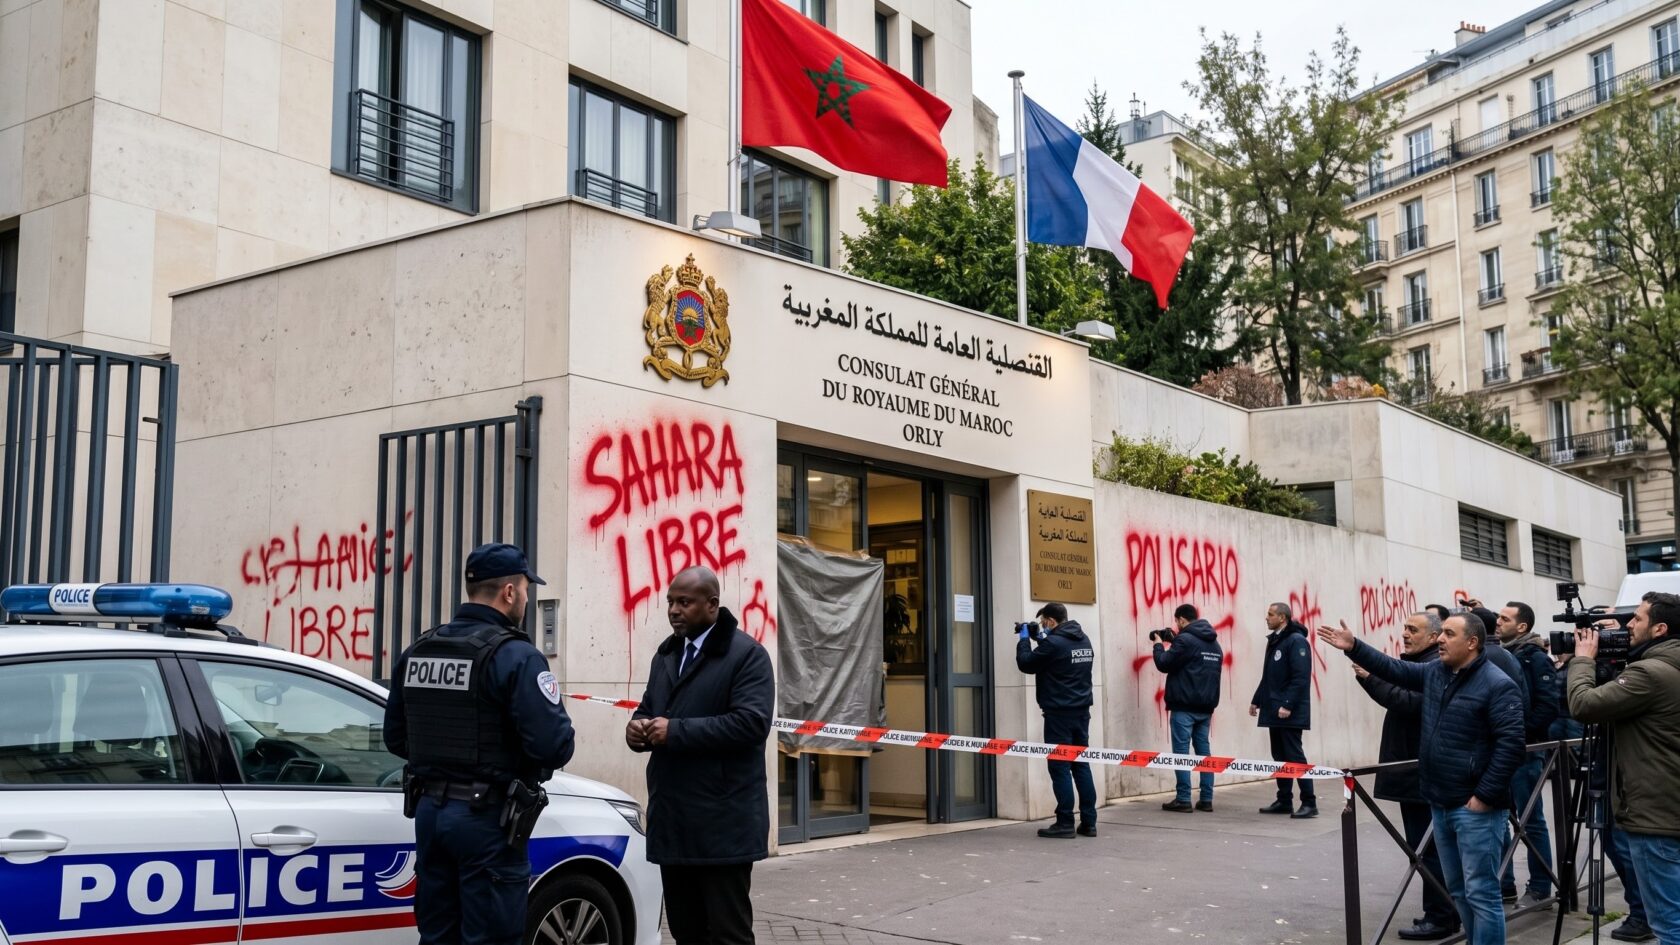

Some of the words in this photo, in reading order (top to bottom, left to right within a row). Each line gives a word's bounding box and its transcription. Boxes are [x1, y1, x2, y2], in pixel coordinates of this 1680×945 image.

[782, 284, 857, 329] المغربية
[865, 306, 928, 347] للمملكة
[934, 325, 980, 360] العامة
[986, 339, 1052, 379] القنصلية
[838, 354, 925, 389] CONSULAT
[930, 374, 1000, 407] GÉNÉRAL
[822, 379, 847, 400] DU
[852, 385, 931, 419] ROYAUME
[934, 403, 955, 424] DU
[960, 409, 1013, 437] MAROC
[903, 424, 944, 447] ORLY
[585, 422, 745, 530] SAHARA
[616, 503, 747, 613] LIBRE
[1126, 533, 1239, 619] POLISARIO
[54, 588, 90, 603] POLICE
[407, 661, 468, 686] POLICE
[1007, 744, 1029, 754] POLICE
[1076, 750, 1100, 760] POLICE
[1148, 756, 1173, 766] POLICE
[1226, 762, 1252, 772] POLICE
[58, 852, 366, 921] POLICE
